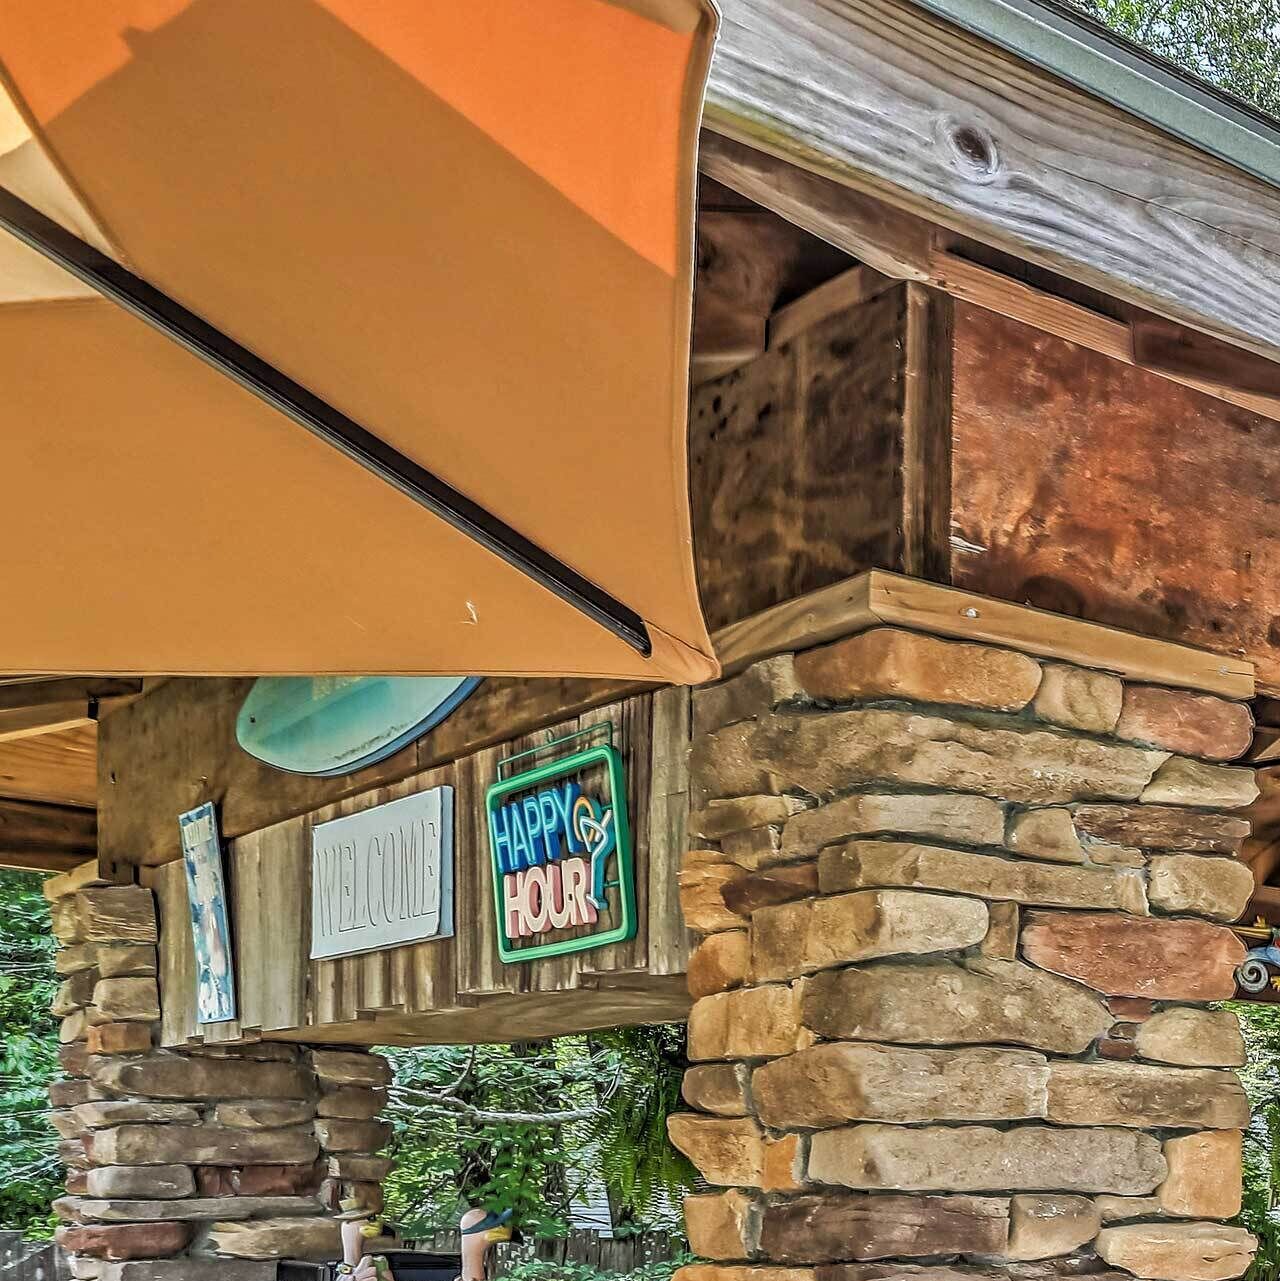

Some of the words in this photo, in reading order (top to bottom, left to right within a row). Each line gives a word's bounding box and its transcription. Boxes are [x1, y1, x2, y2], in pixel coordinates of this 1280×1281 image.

[491, 780, 583, 873] HAPPY
[316, 819, 437, 936] WELCOME
[504, 857, 598, 938] HOUR
